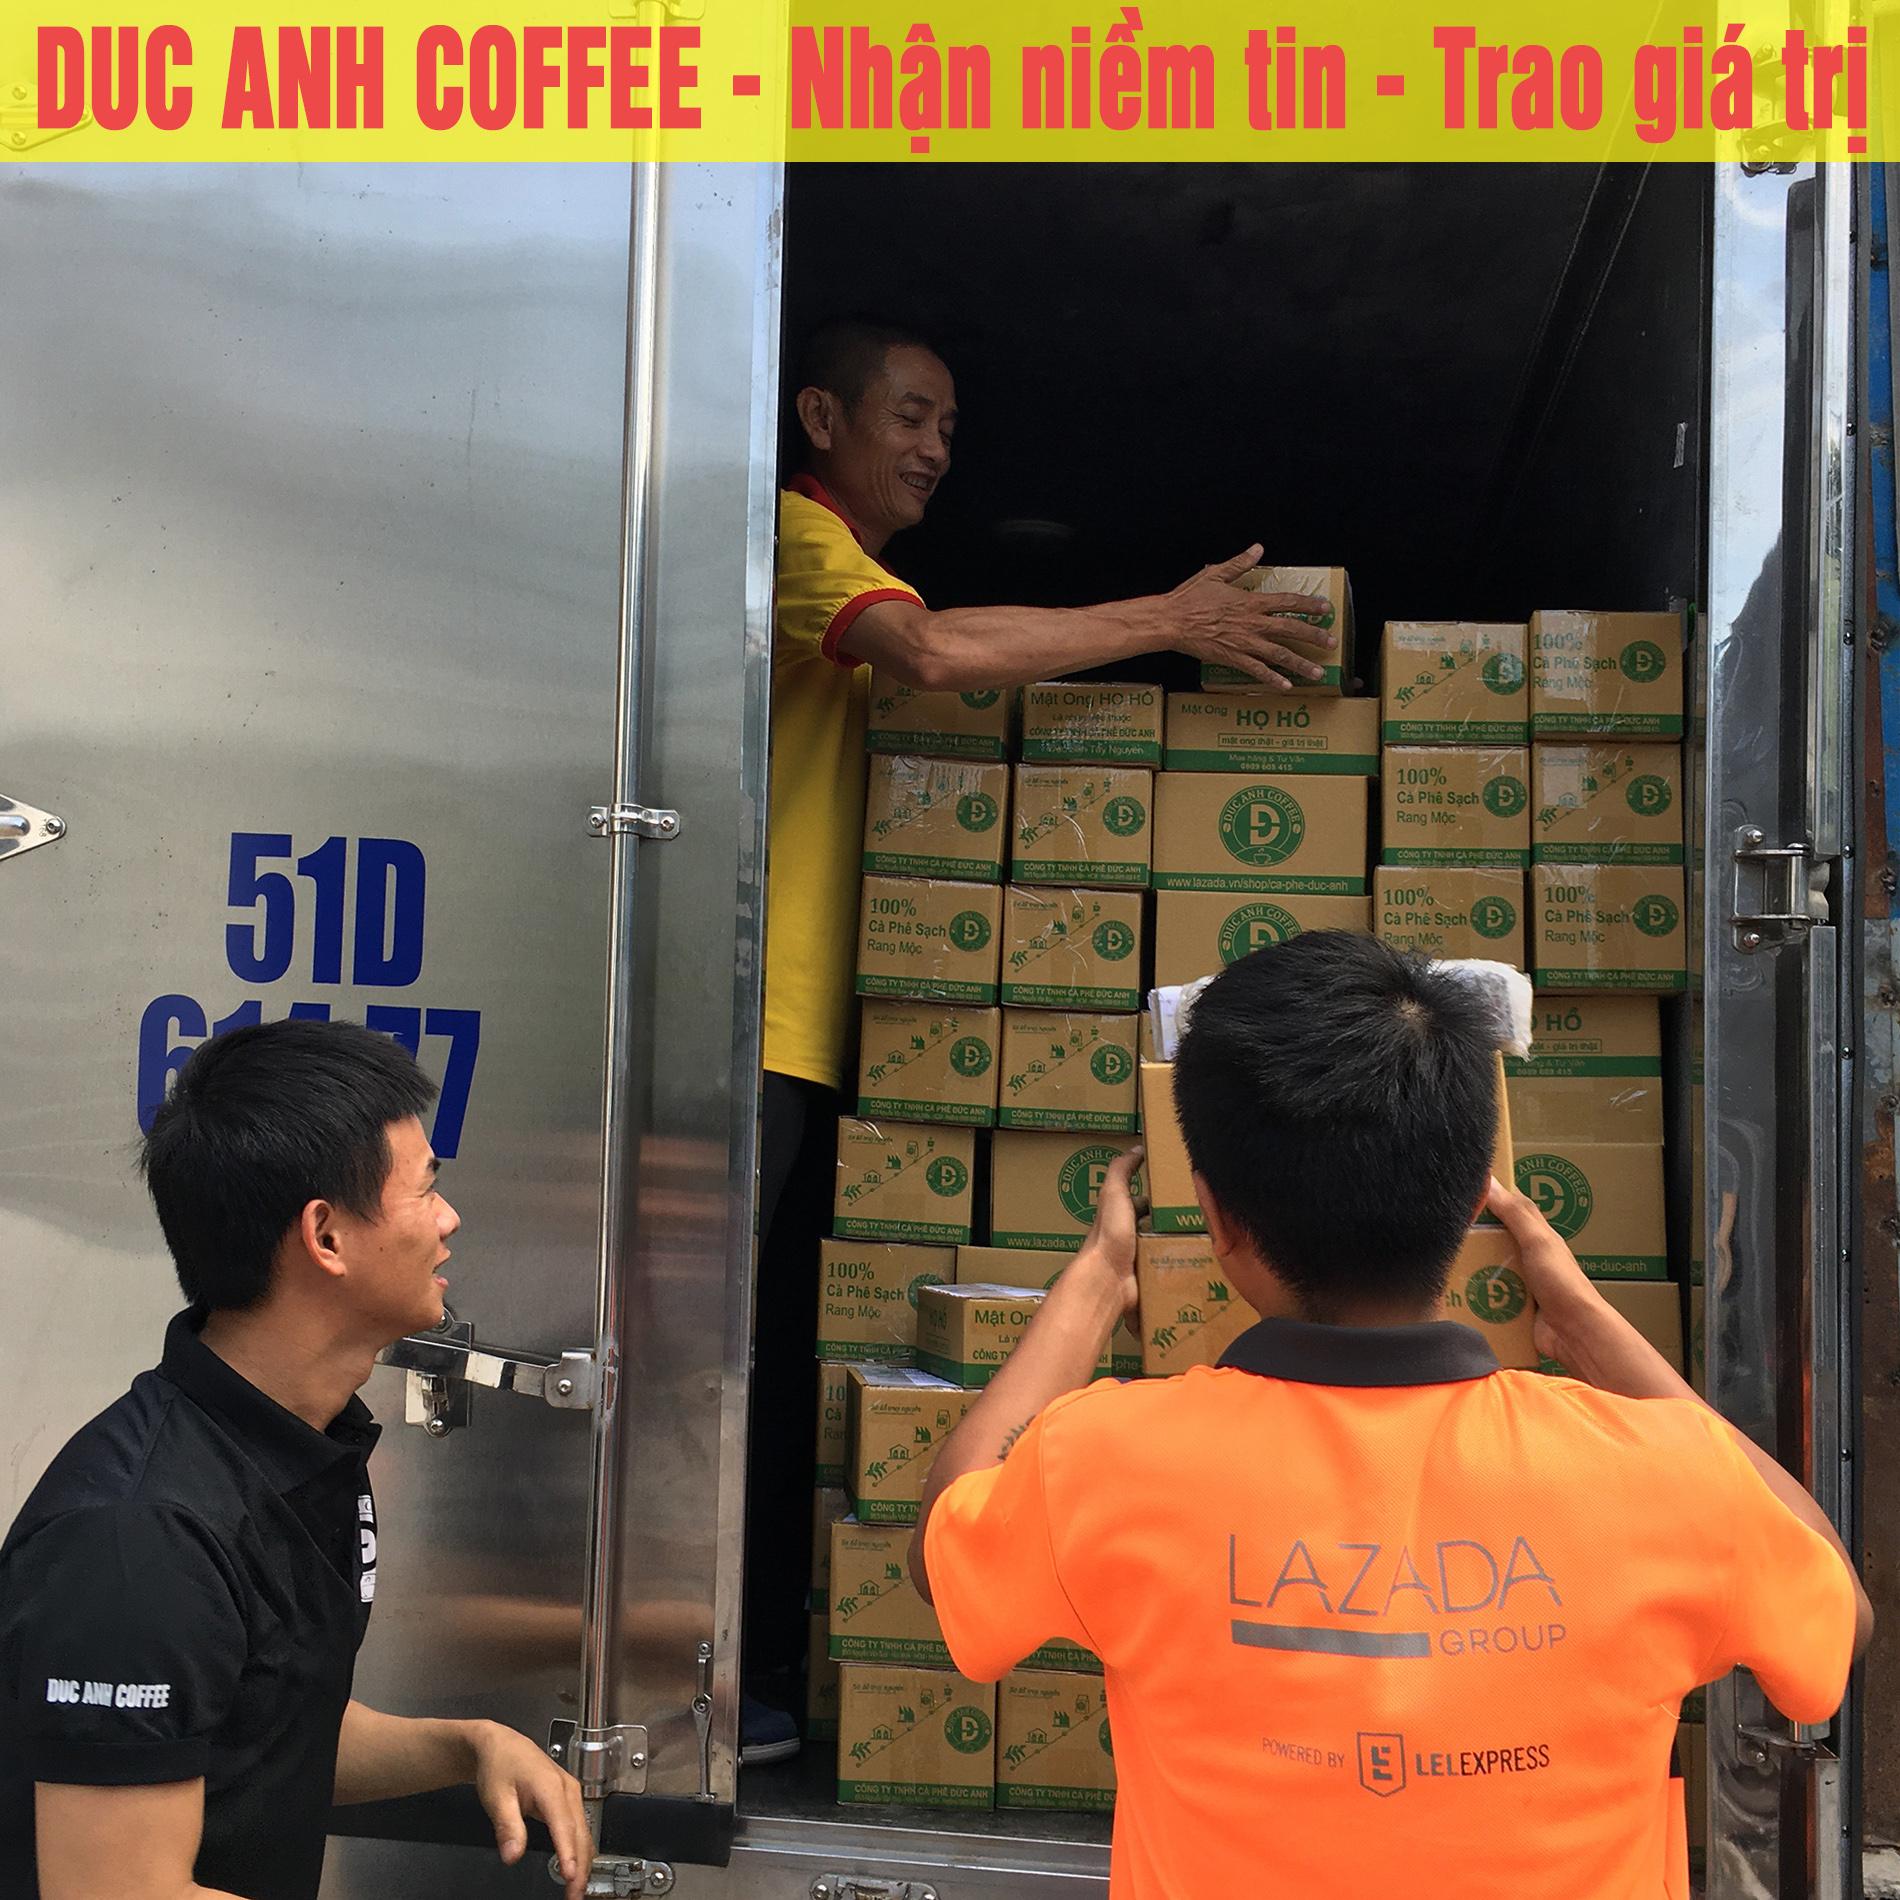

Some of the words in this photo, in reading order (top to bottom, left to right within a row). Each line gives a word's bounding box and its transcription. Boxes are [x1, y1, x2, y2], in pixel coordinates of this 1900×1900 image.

[1236, 710, 1269, 730] HỌ
[1398, 767, 1446, 786] 100%
[1397, 791, 1413, 804] Cà
[1418, 791, 1442, 804] Phê
[1447, 791, 1480, 807] Sạch
[1397, 811, 1427, 826] Rang
[1431, 811, 1456, 824] Mộc
[1047, 864, 1055, 872] TY
[1384, 888, 1434, 906] 100%
[226, 832, 426, 987] 51D
[870, 898, 916, 916] 100%
[868, 920, 884, 932] Cà
[889, 921, 911, 934] Phê
[915, 922, 946, 938] Sạch
[1384, 912, 1400, 926] Cà
[1406, 912, 1430, 926] Phê
[1434, 912, 1466, 928] Sạch
[868, 938, 895, 956] Rang
[900, 941, 922, 954] Mộc
[970, 1108, 986, 1116] ANH
[1112, 1115, 1128, 1123] ANH
[870, 1223, 878, 1231] TY
[948, 1228, 962, 1236] ANH
[828, 1262, 874, 1280] 100%
[826, 1284, 842, 1296] Cà
[847, 1286, 870, 1299] Phê
[874, 1287, 904, 1302] Sạch
[826, 1303, 854, 1319] Rang
[858, 1305, 881, 1319] Mộc
[974, 1309, 1004, 1326] Mật
[1010, 1310, 1032, 1326] On
[972, 1349, 998, 1360] CÔNG
[897, 1504, 908, 1513] TY
[1229, 1533, 1563, 1616] LAZADA
[1439, 1624, 1567, 1657] GROUP
[46, 1678, 80, 1704] DUC
[115, 1684, 171, 1708] COFFEE
[1262, 1737, 1322, 1766] POWERED
[1327, 1752, 1345, 1768] BY
[1416, 1744, 1550, 1777] LELEXPRESS
[882, 1786, 890, 1794] TY
[971, 1789, 988, 1798] ANH
